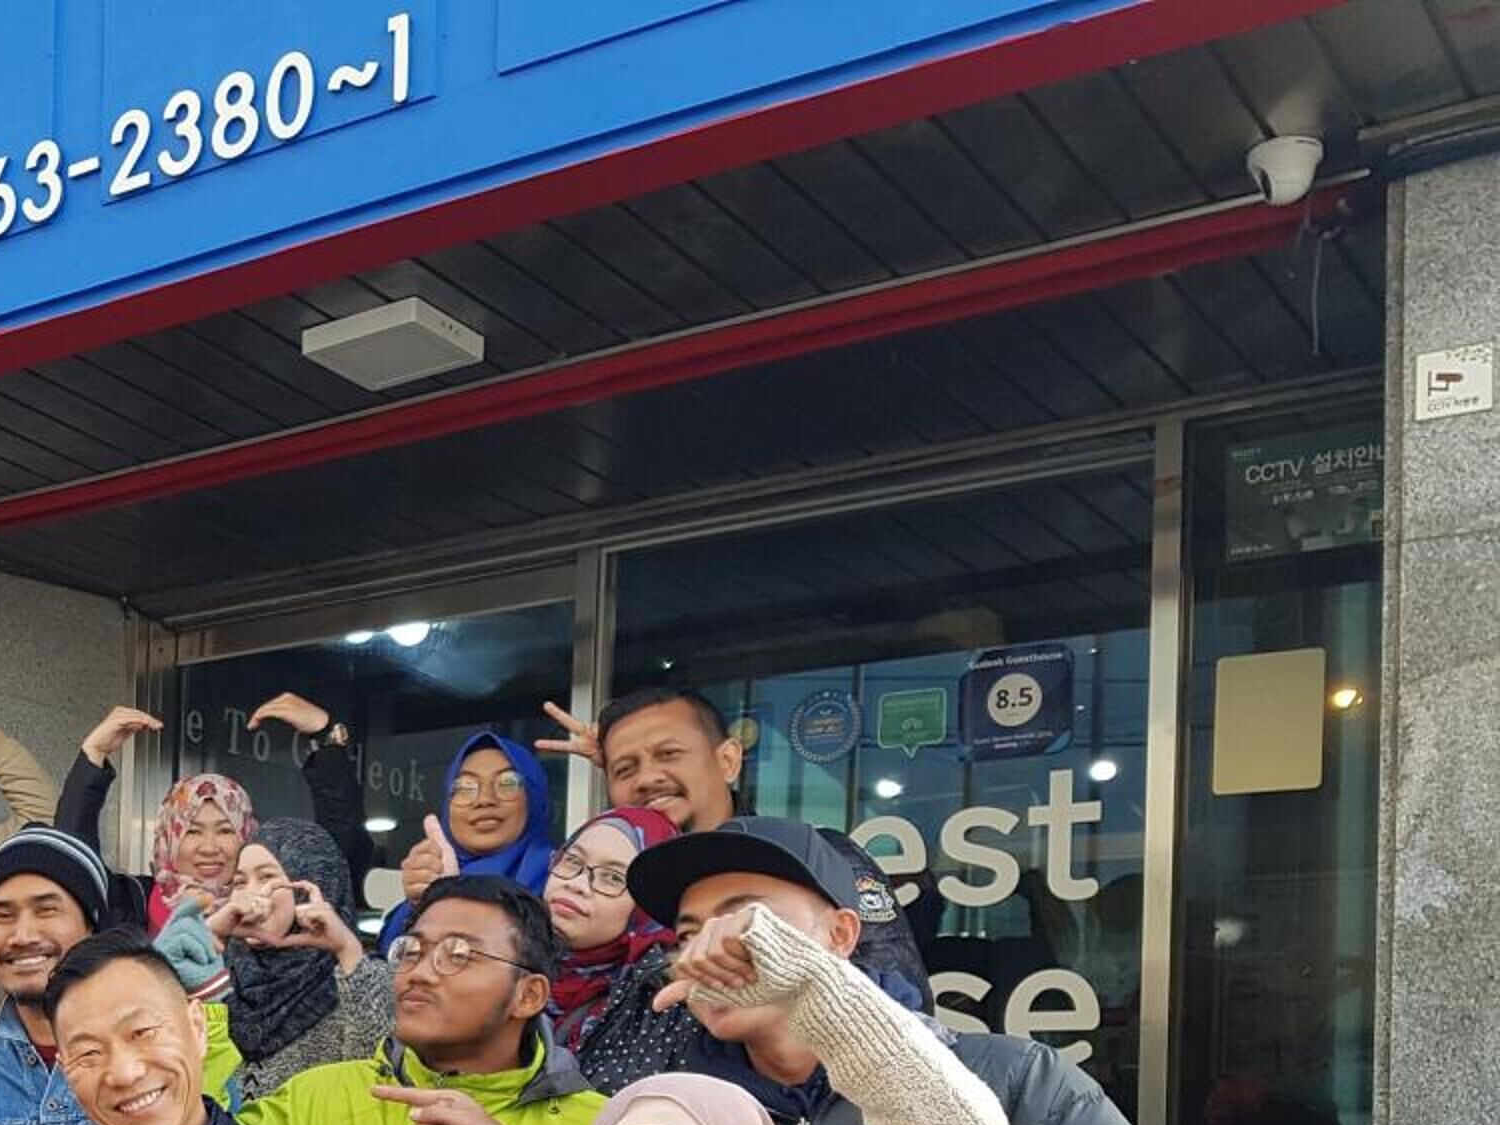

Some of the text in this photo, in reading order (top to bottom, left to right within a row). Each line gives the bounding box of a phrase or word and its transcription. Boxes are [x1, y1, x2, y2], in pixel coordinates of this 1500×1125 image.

[1245, 457, 1305, 484] CCTV
[995, 687, 1033, 709] 8.5
[225, 707, 271, 762] To
[850, 769, 1102, 907] est
